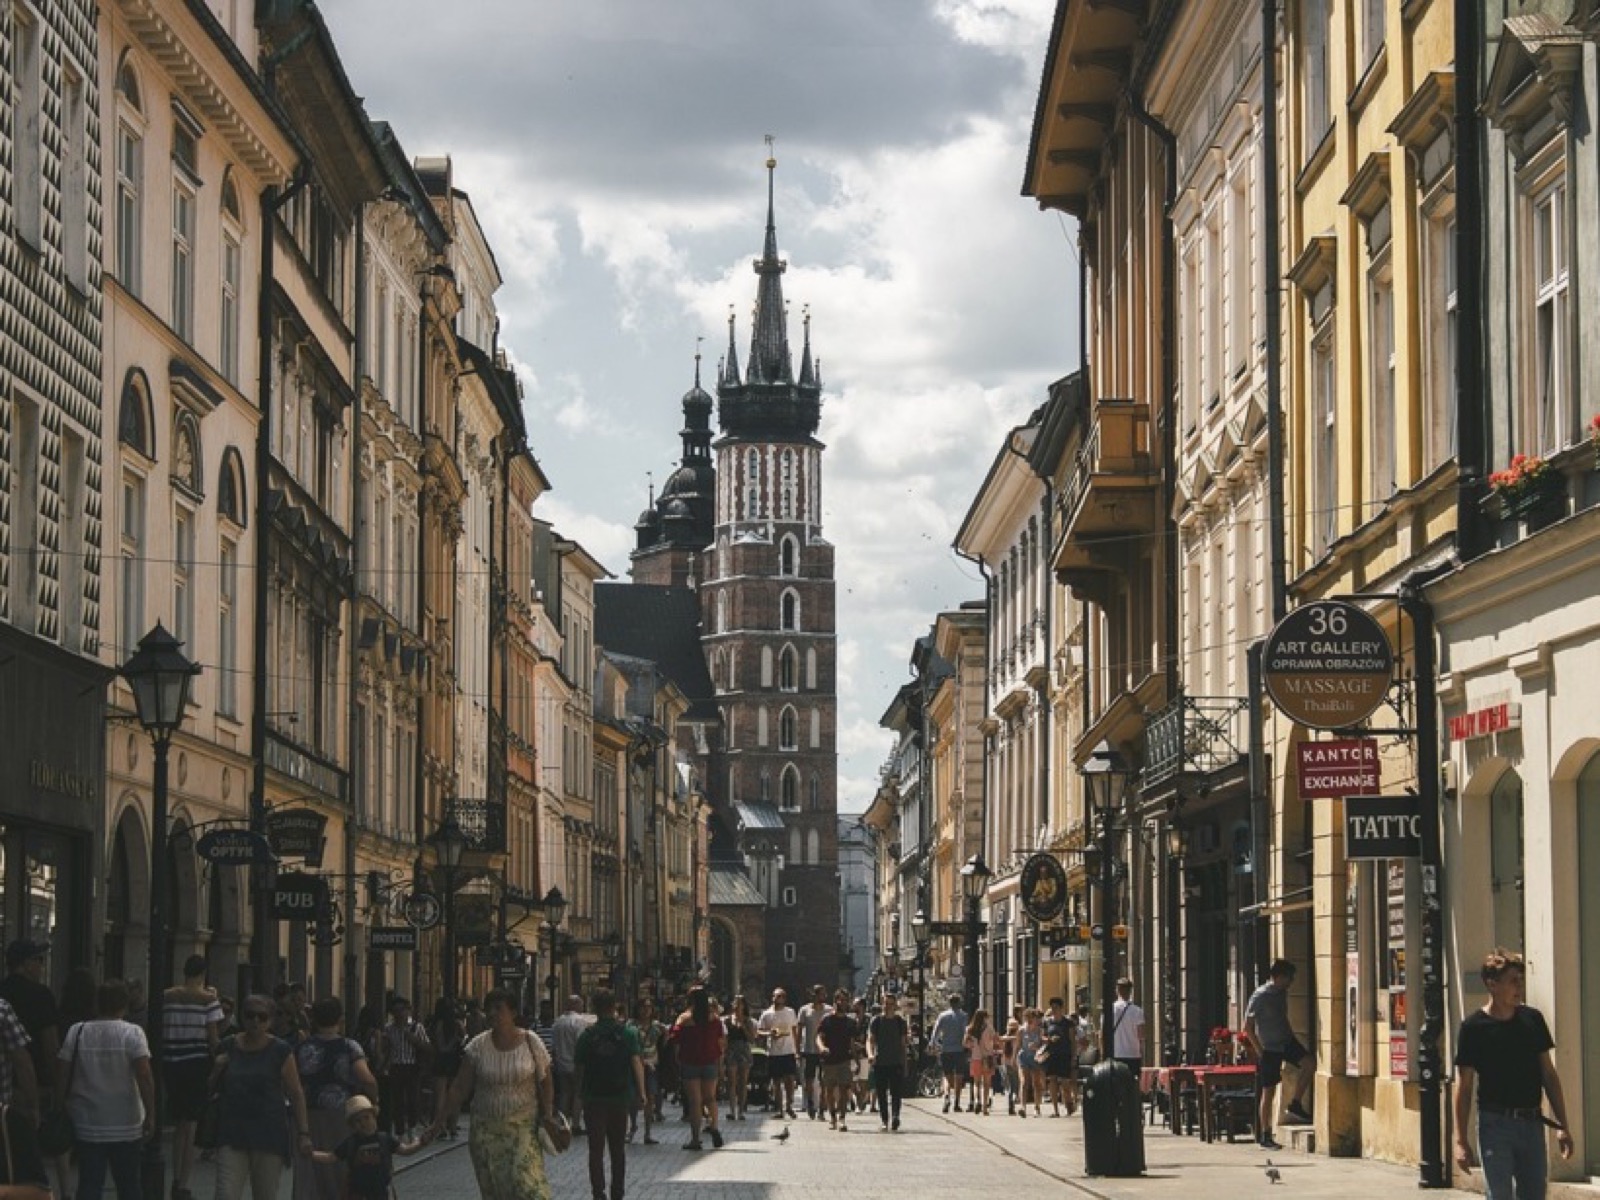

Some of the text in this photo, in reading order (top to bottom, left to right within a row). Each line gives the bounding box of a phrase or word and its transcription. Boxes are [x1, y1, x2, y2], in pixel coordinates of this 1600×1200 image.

[1308, 606, 1348, 635] 36
[1275, 641, 1381, 655] ART GALLERY
[1271, 659, 1323, 670] OPRAWA
[1285, 678, 1373, 694] MASSAGE
[1302, 747, 1375, 763] KANTOR
[1304, 774, 1376, 790] EXCHANGE
[210, 846, 253, 858] OPTYK
[274, 891, 314, 908] PUB
